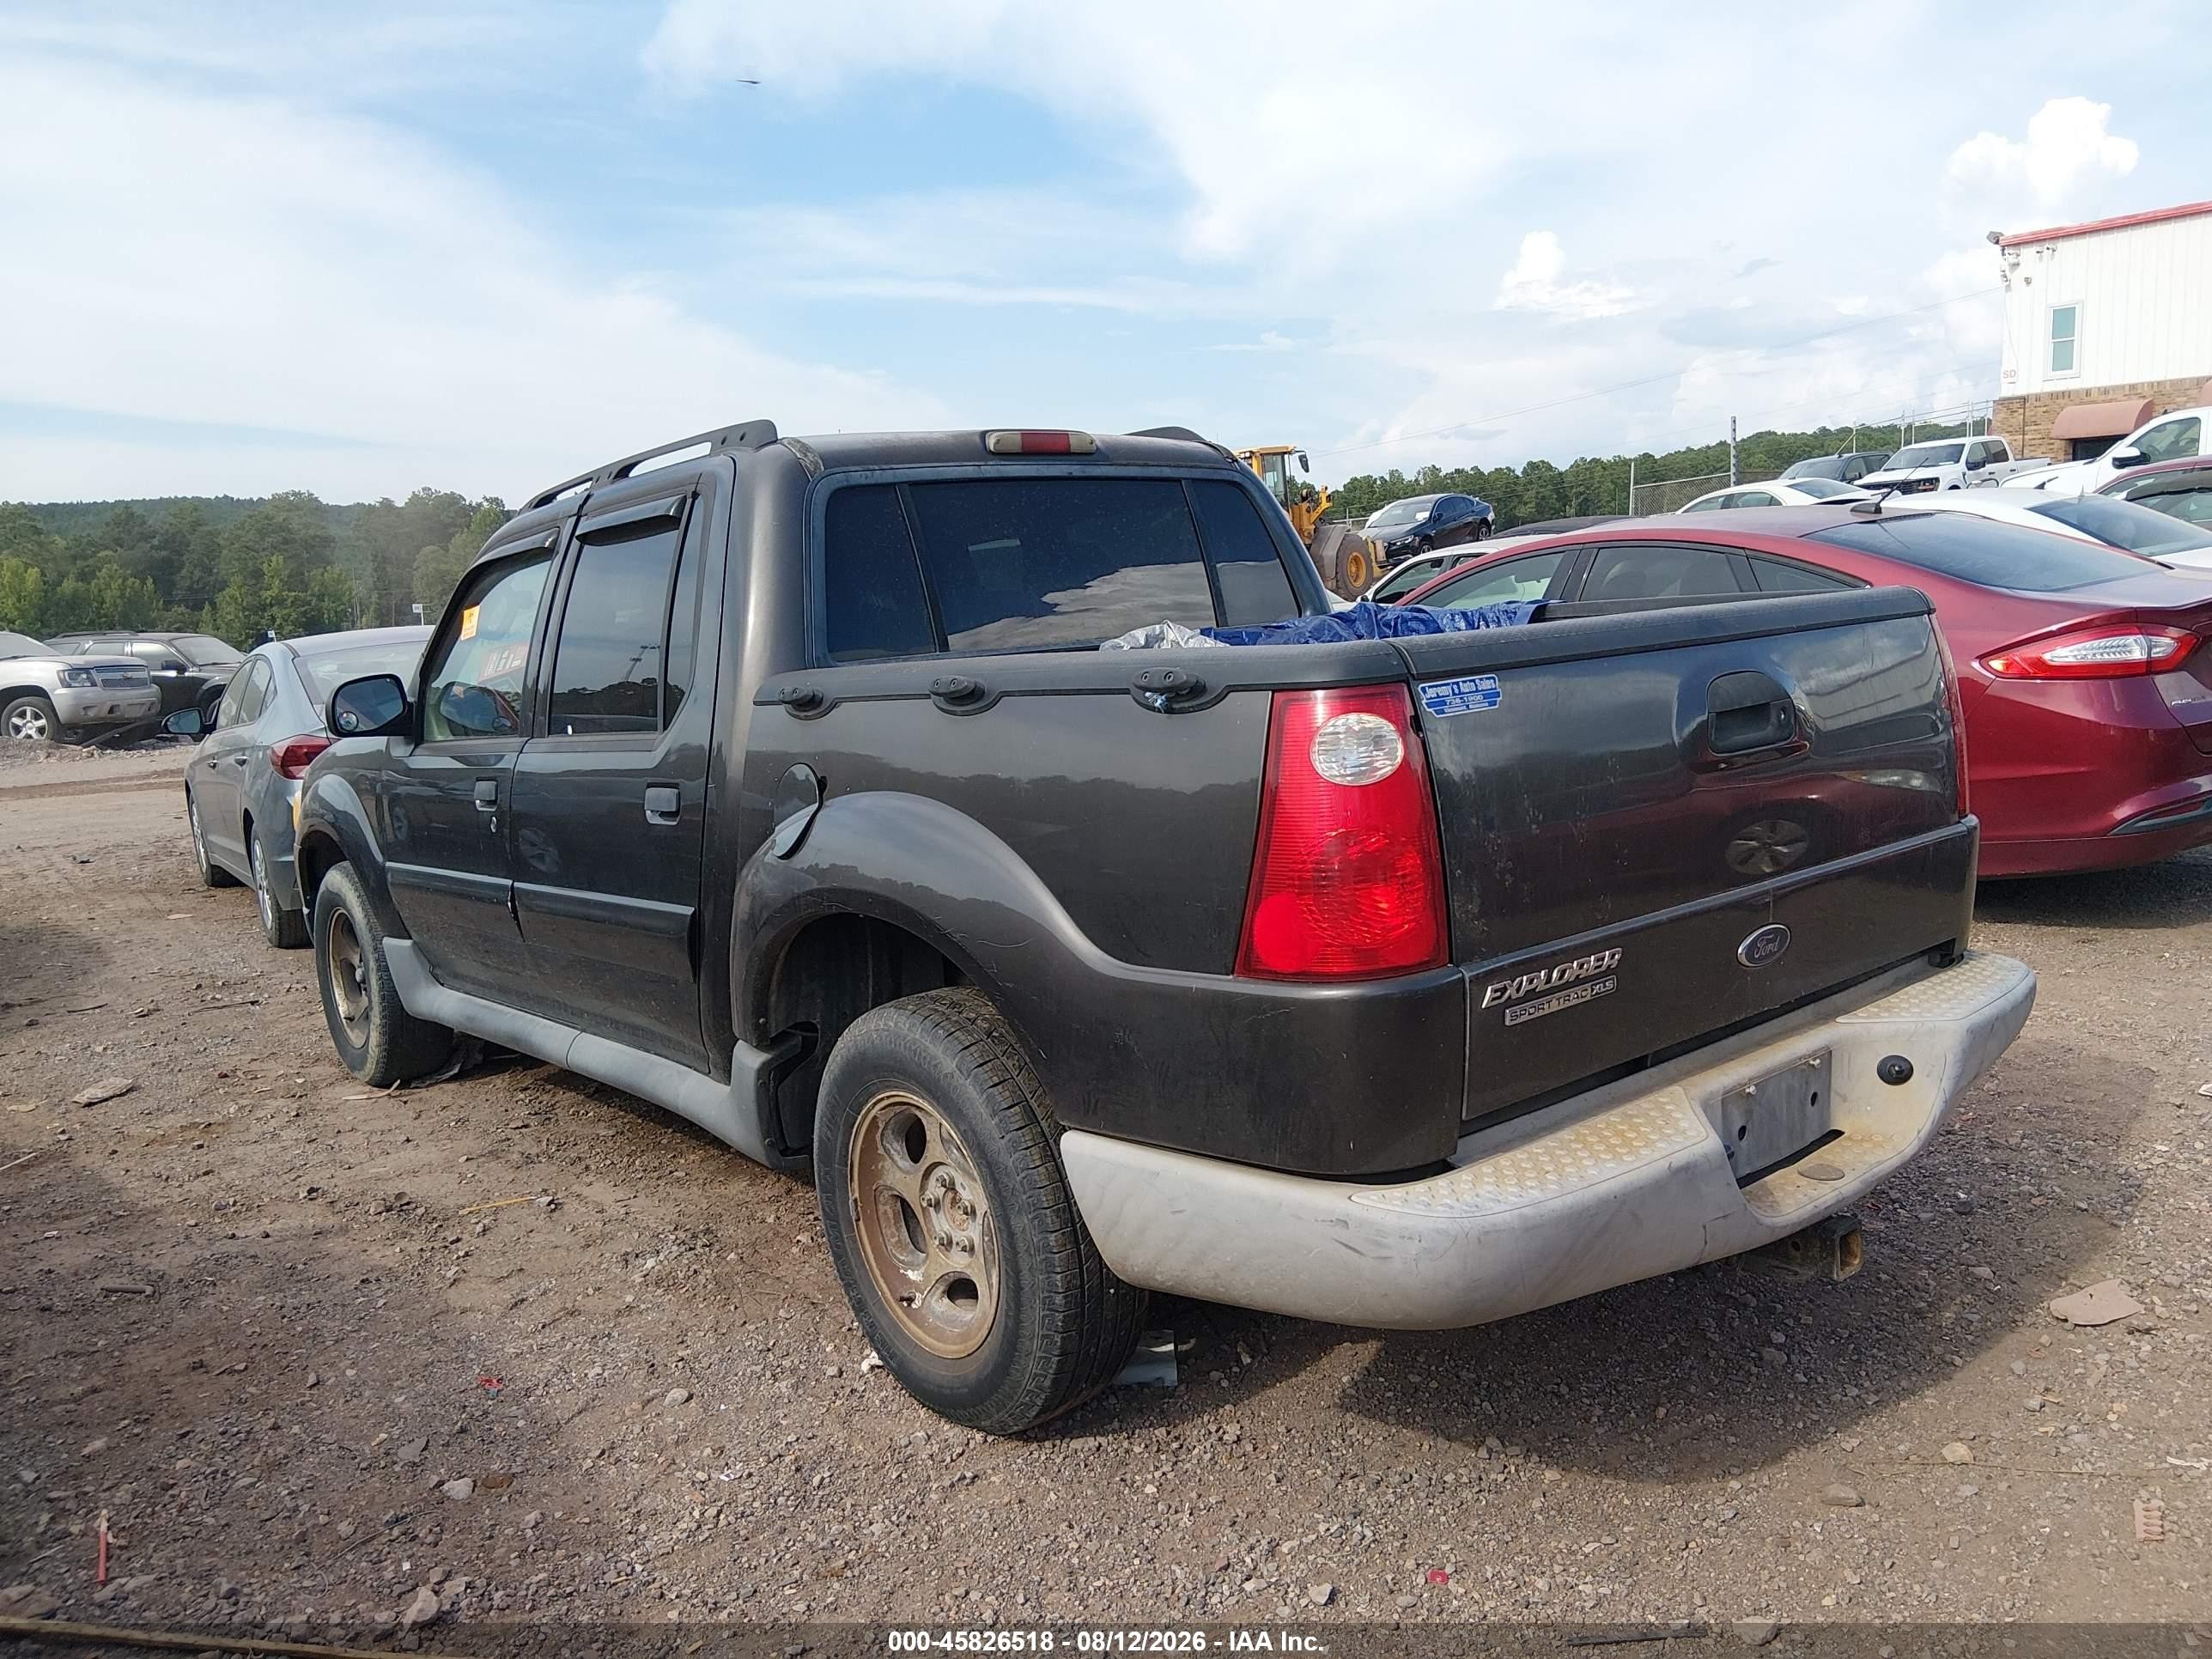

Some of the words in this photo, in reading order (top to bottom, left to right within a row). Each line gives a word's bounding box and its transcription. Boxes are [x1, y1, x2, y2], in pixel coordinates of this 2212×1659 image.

[1425, 683, 1459, 699] Jeremy's
[1459, 681, 1476, 693] Auto
[1475, 678, 1496, 690] Sales
[1753, 933, 1780, 958] Ford
[1480, 947, 1622, 1009] EXPLORER
[1510, 1000, 1553, 1022] SPORT
[1556, 988, 1589, 1007] TRAC
[1590, 979, 1614, 995] XLS
